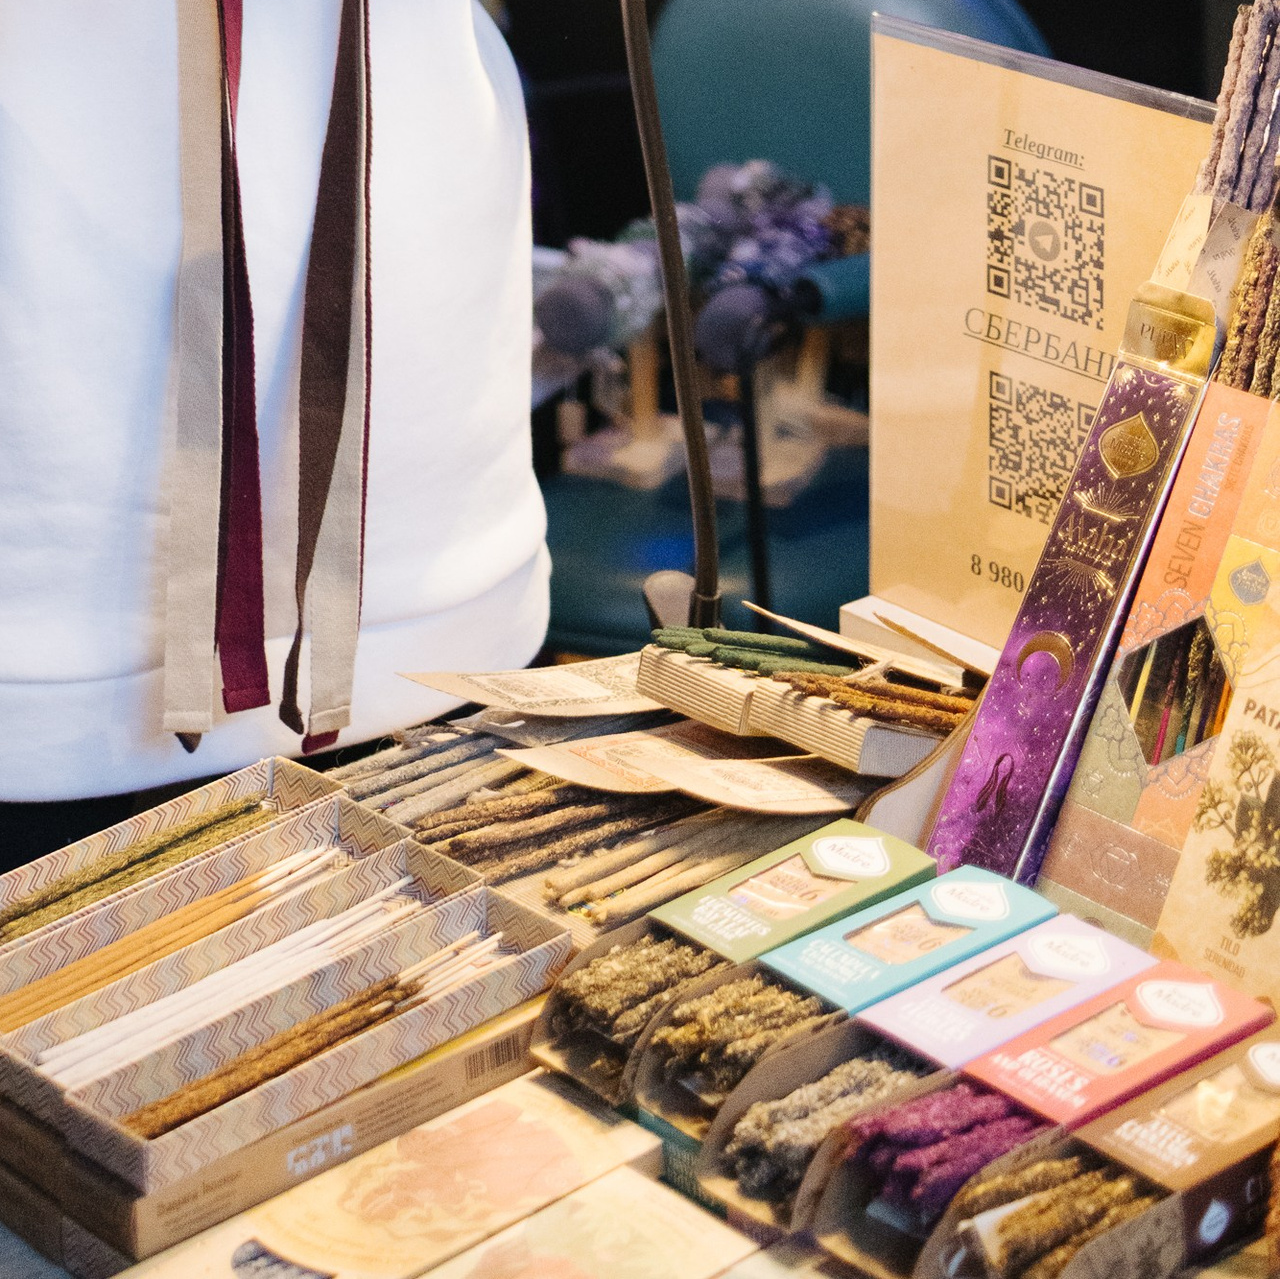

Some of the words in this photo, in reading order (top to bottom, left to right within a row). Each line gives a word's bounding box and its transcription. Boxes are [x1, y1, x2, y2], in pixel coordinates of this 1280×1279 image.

[1004, 128, 1085, 168] Telegram:
[1163, 519, 1206, 589] SEVEN
[1188, 412, 1242, 519] CHAKRAS
[971, 553, 982, 576] 8
[989, 561, 1024, 593] 980
